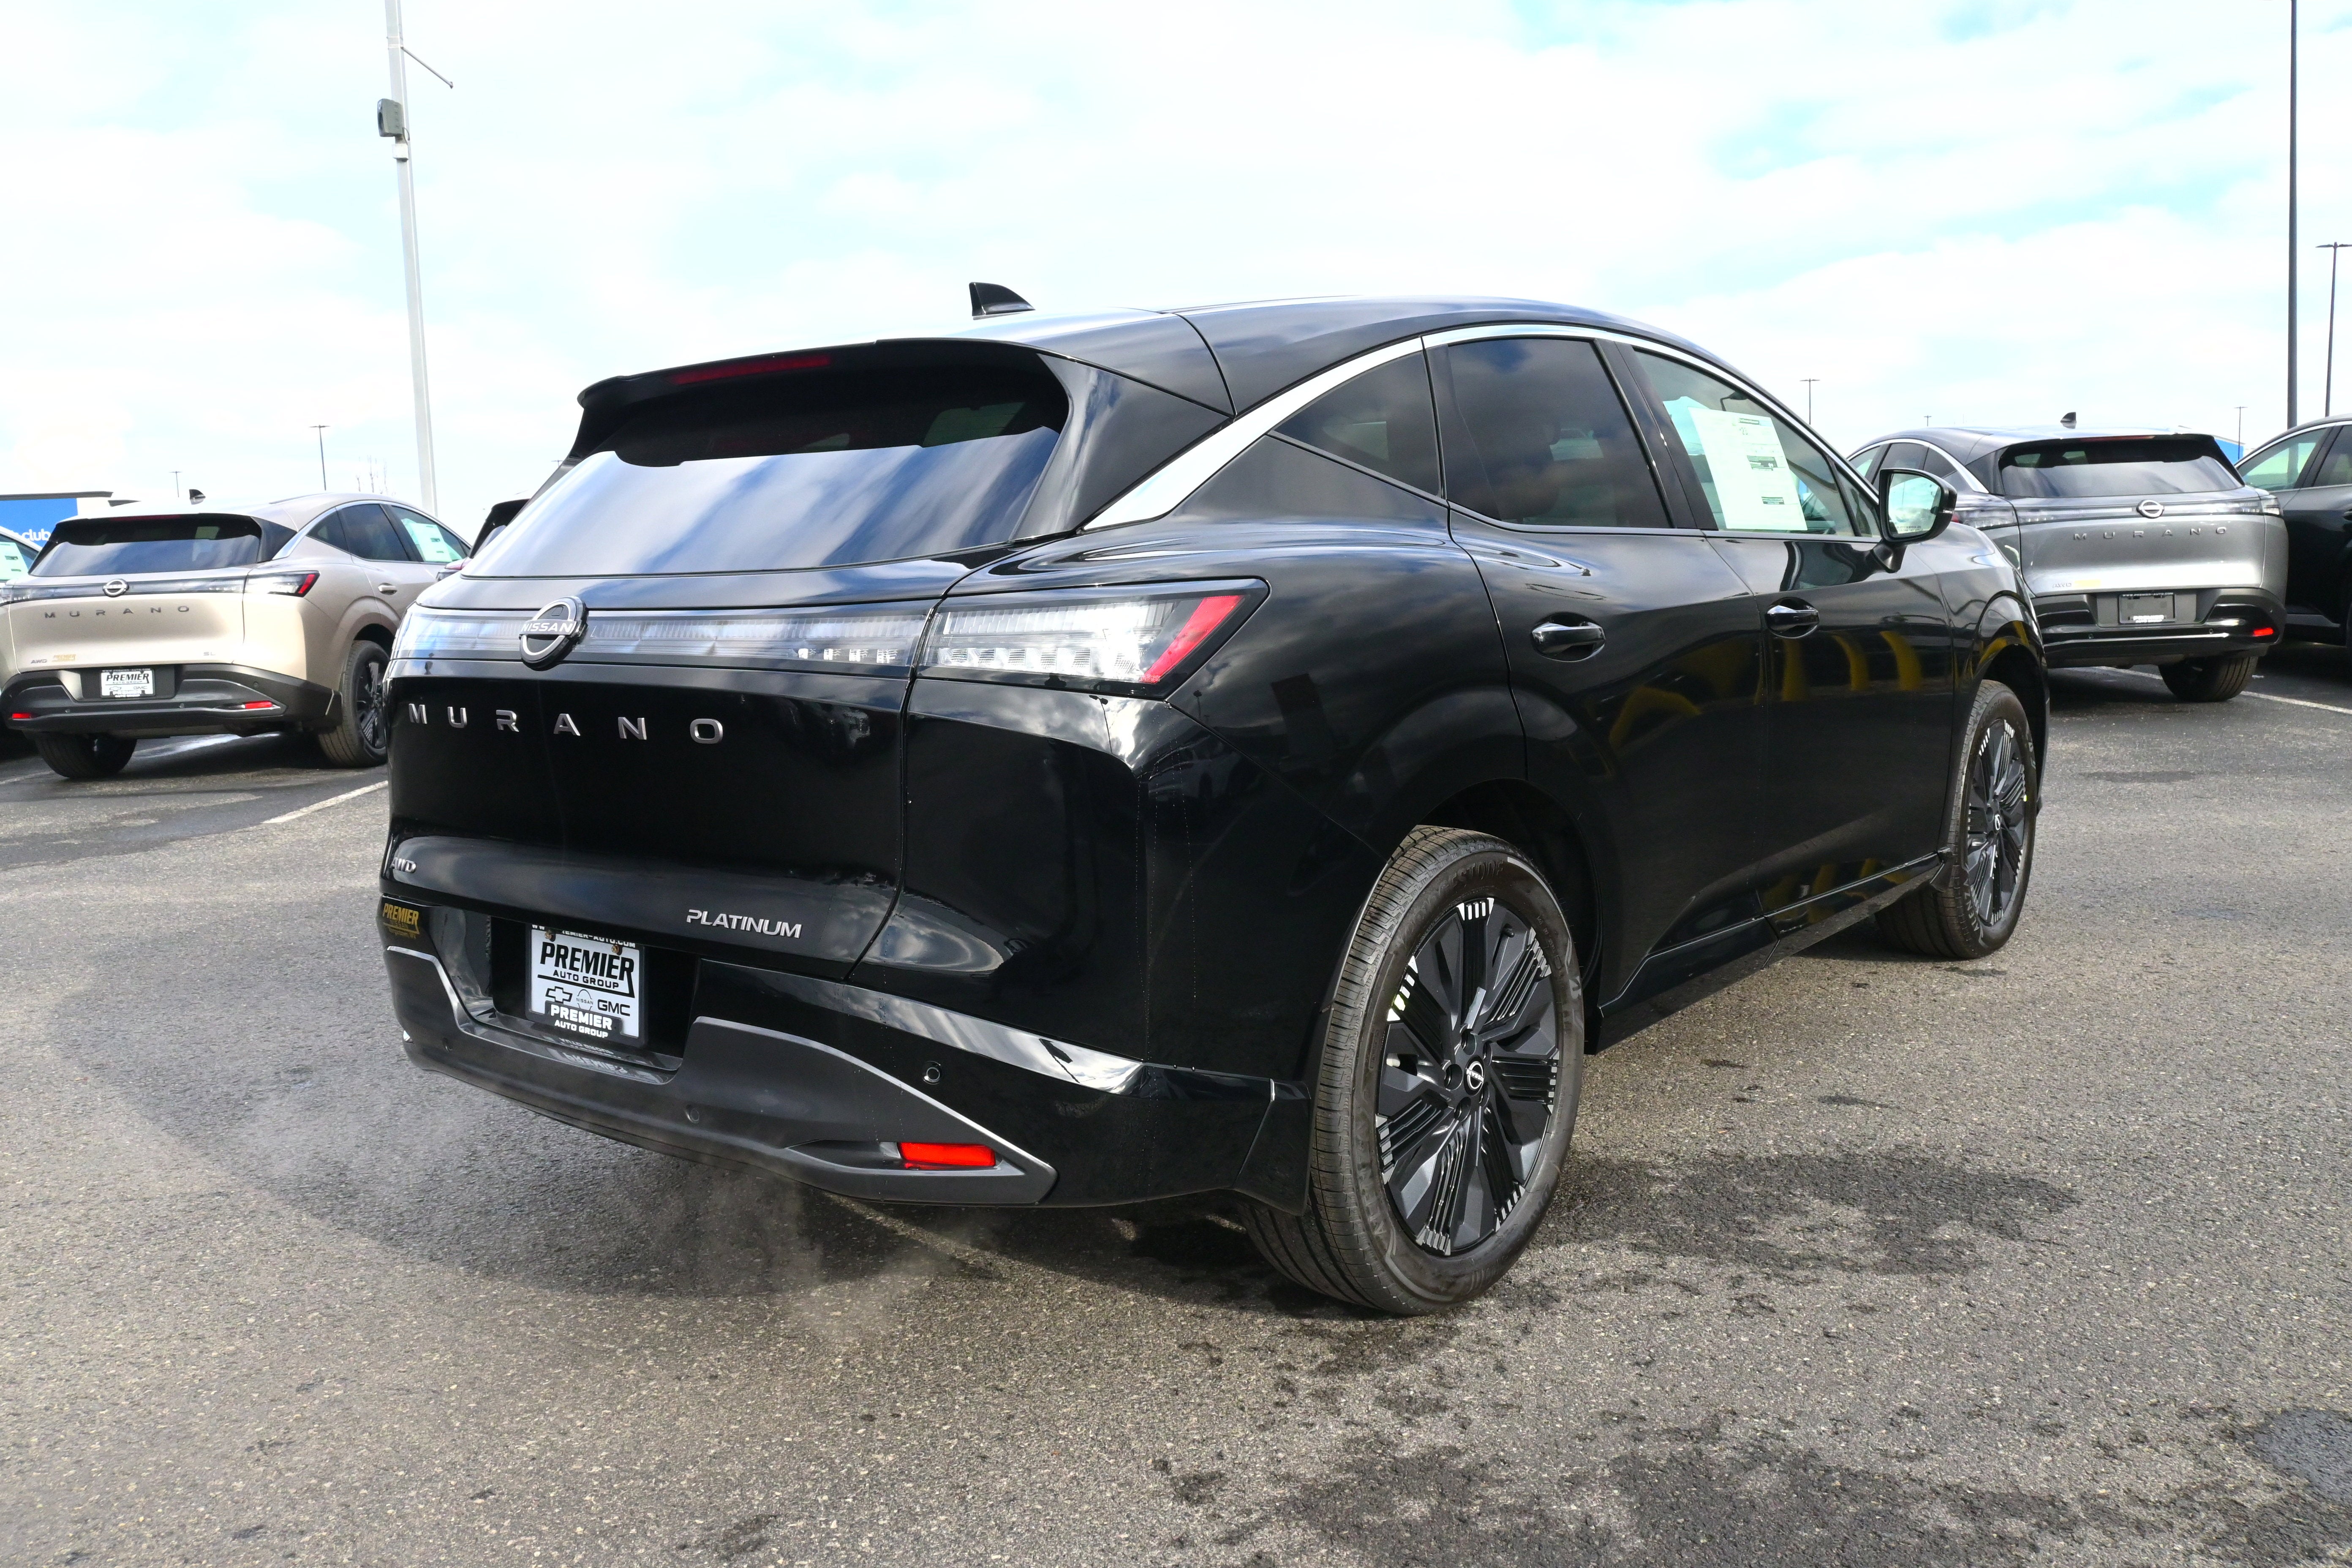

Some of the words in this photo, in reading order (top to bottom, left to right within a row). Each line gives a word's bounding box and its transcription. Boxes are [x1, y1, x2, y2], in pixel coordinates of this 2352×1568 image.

[22, 528, 51, 541] club
[2073, 526, 2227, 540] MURANO
[44, 606, 189, 618] MURANO
[521, 622, 573, 632] NISSAN
[106, 673, 150, 683] PREMIER
[408, 703, 723, 744] MURANO
[390, 857, 416, 873] AWD
[382, 903, 419, 927] PREMIER
[686, 909, 802, 939] PLATINUM
[540, 942, 634, 984] PREMIER
[553, 969, 579, 981] AUTO
[582, 976, 619, 989] GROUP
[597, 999, 630, 1016] GMC
[551, 1004, 612, 1030] PREMIER
[554, 1020, 577, 1031] AUTO
[579, 1026, 608, 1038] GROUP
